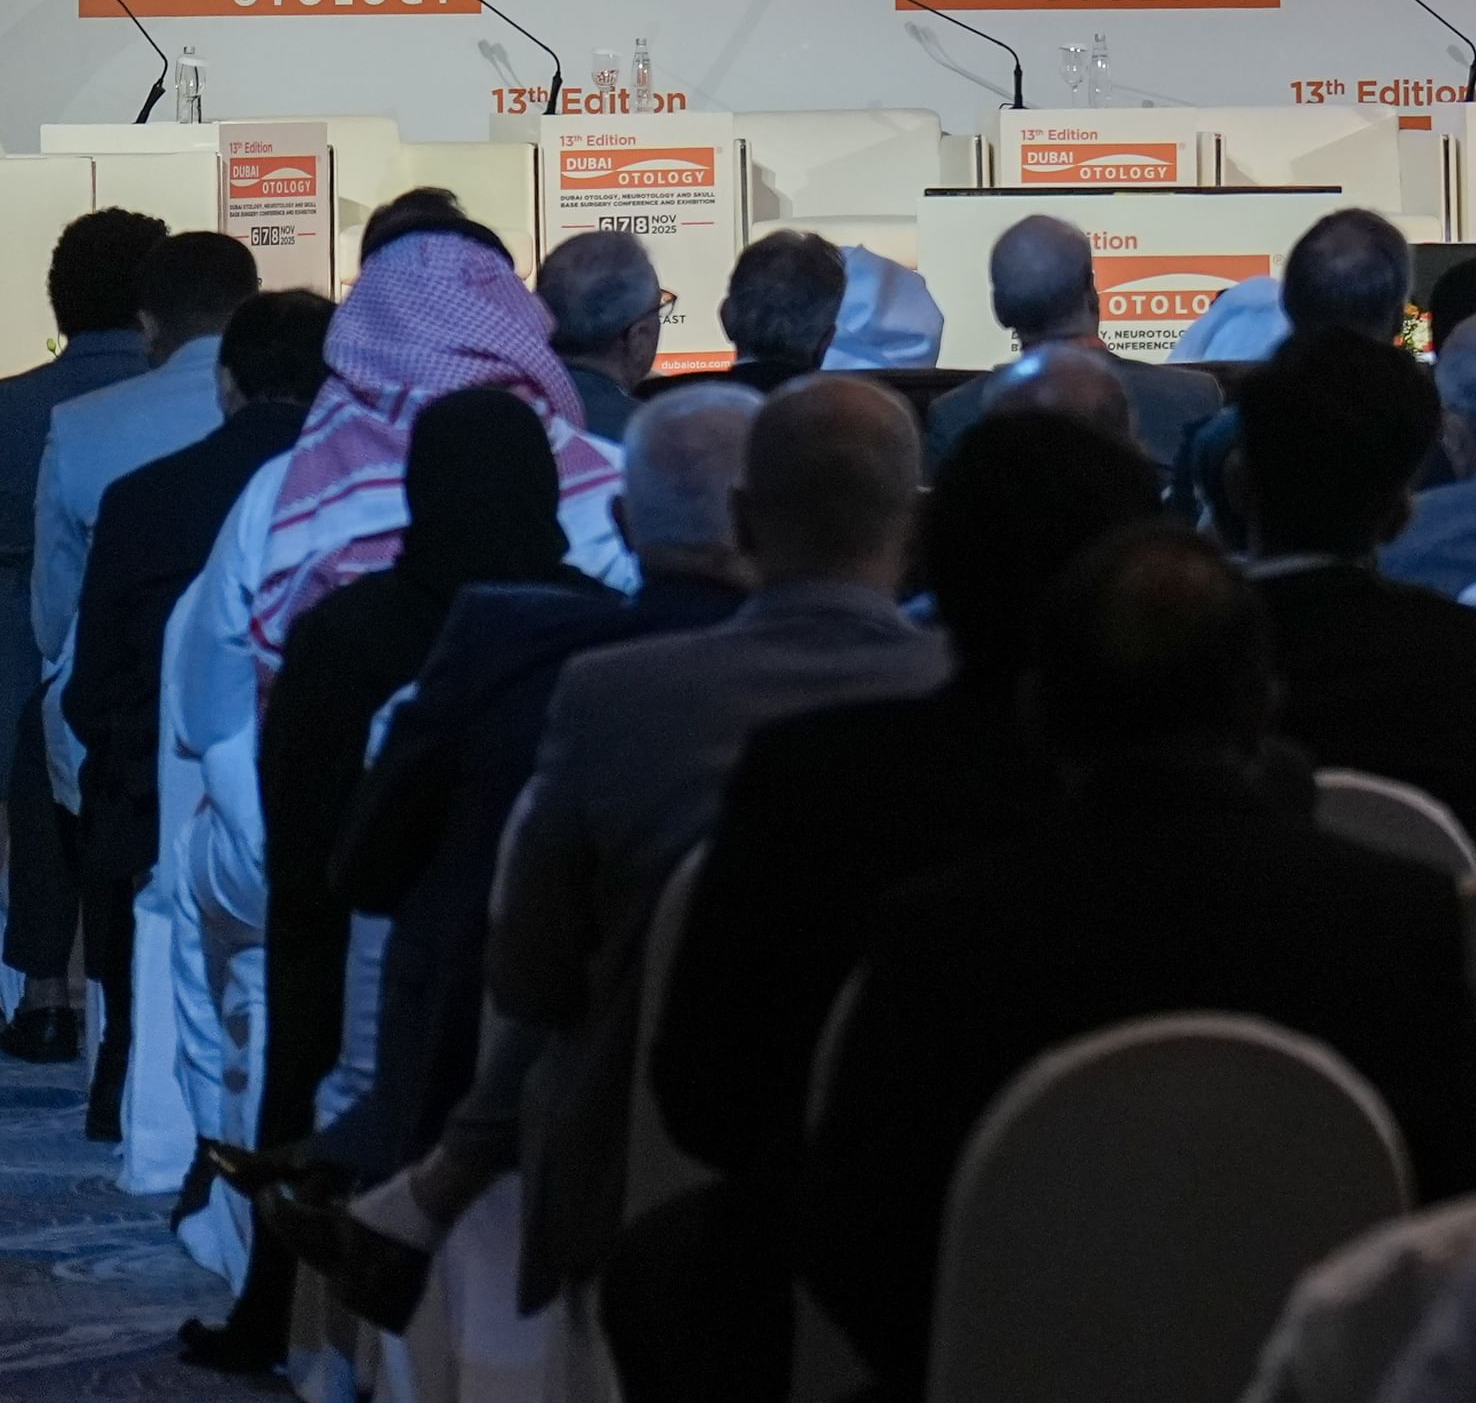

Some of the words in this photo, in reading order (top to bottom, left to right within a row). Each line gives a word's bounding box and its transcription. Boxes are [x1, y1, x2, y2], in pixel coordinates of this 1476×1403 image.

[1291, 80, 1344, 103] 13th
[1021, 130, 1043, 140] 13th
[1049, 129, 1097, 140] Edition
[560, 135, 582, 146] 13th
[587, 135, 635, 145] Edition
[245, 142, 272, 153] Edition
[1028, 152, 1073, 163] DUBAI
[567, 158, 611, 170] DUBAI
[233, 166, 259, 177] DUBAI
[1080, 167, 1167, 179] OTOLOGY
[619, 171, 704, 184] OTOLOGY
[263, 181, 311, 194] OTOLOGY
[652, 215, 677, 223] NOV
[281, 226, 295, 235] NOV
[652, 225, 677, 233] 2025
[281, 237, 295, 245] 2025
[1109, 295, 1210, 314] OTOLO
